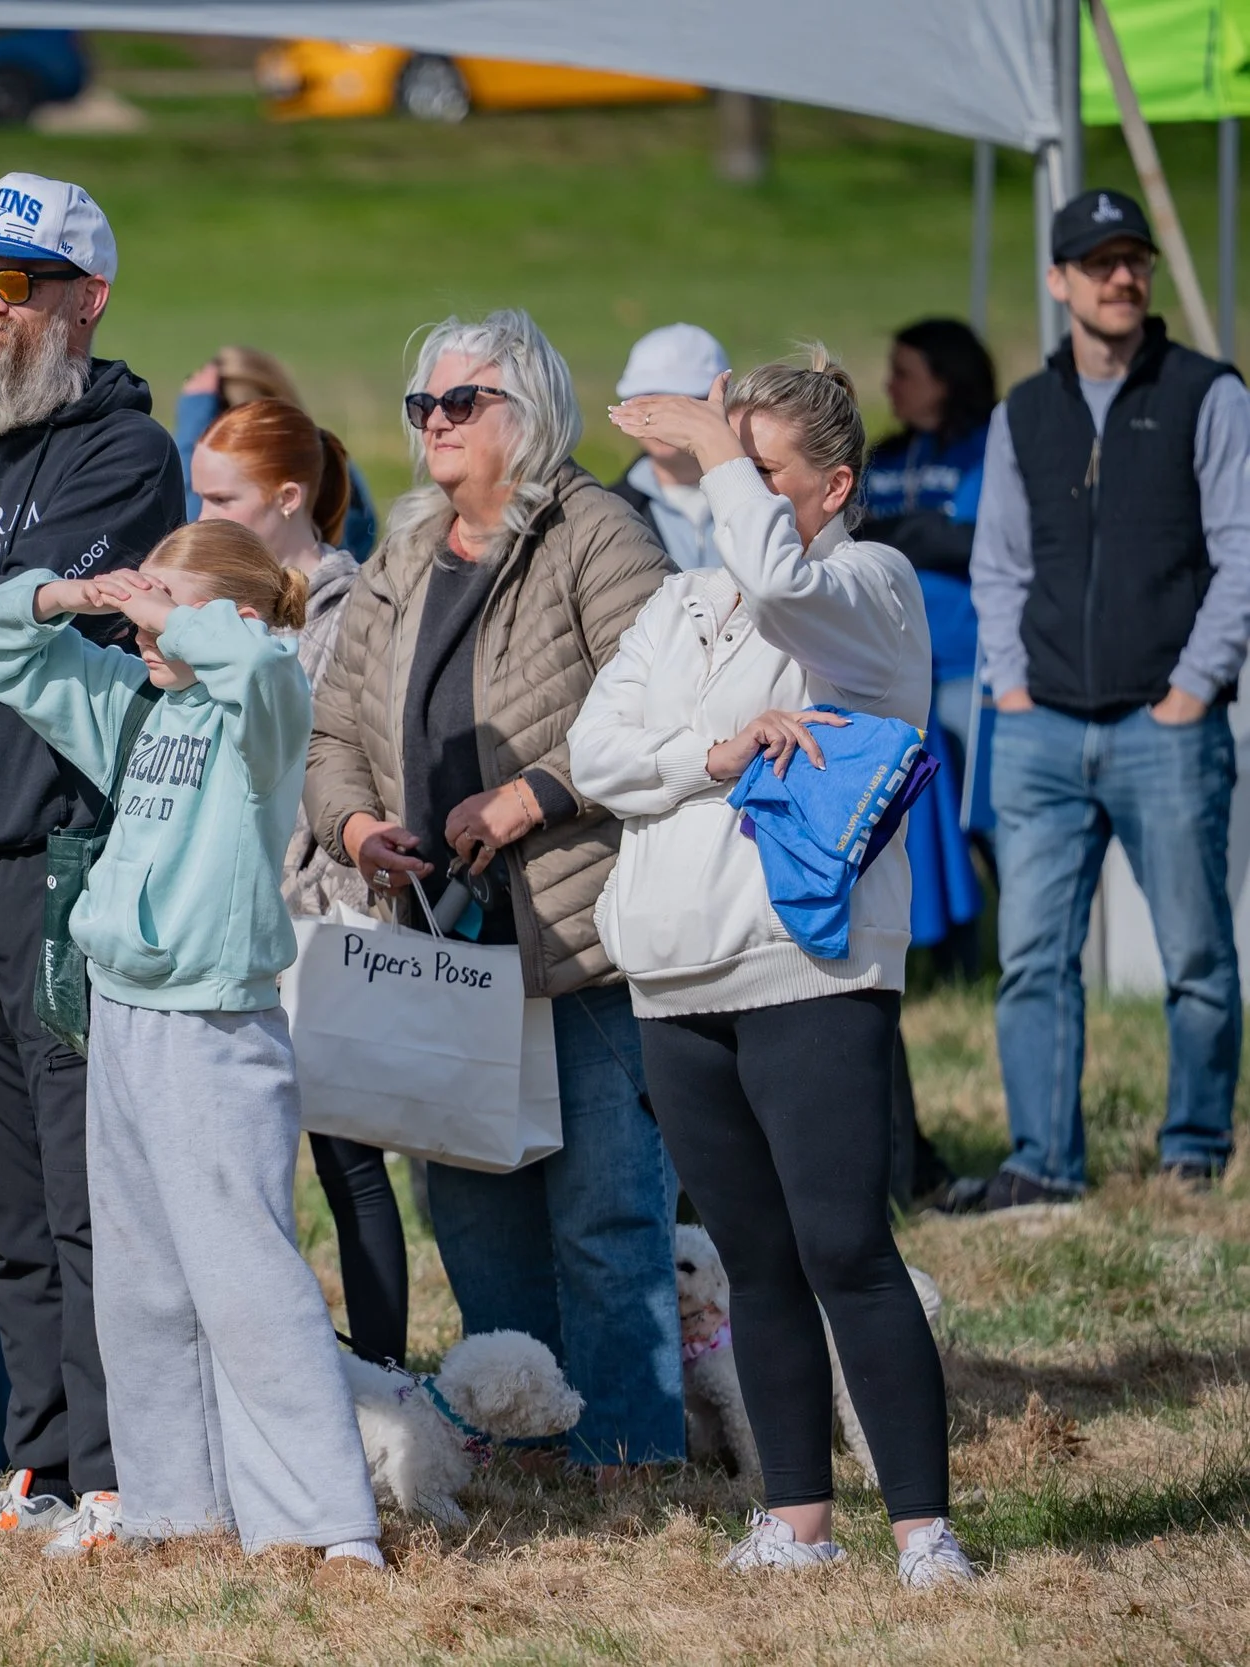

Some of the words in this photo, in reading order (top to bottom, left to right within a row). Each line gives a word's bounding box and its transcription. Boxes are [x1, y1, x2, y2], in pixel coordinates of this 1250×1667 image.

[64, 534, 110, 580] OLOGY
[868, 764, 888, 793] EVERY
[857, 791, 872, 814] STEP
[45, 938, 57, 1011] lululemon
[344, 933, 422, 983] Piper's
[435, 951, 492, 988] Posse
